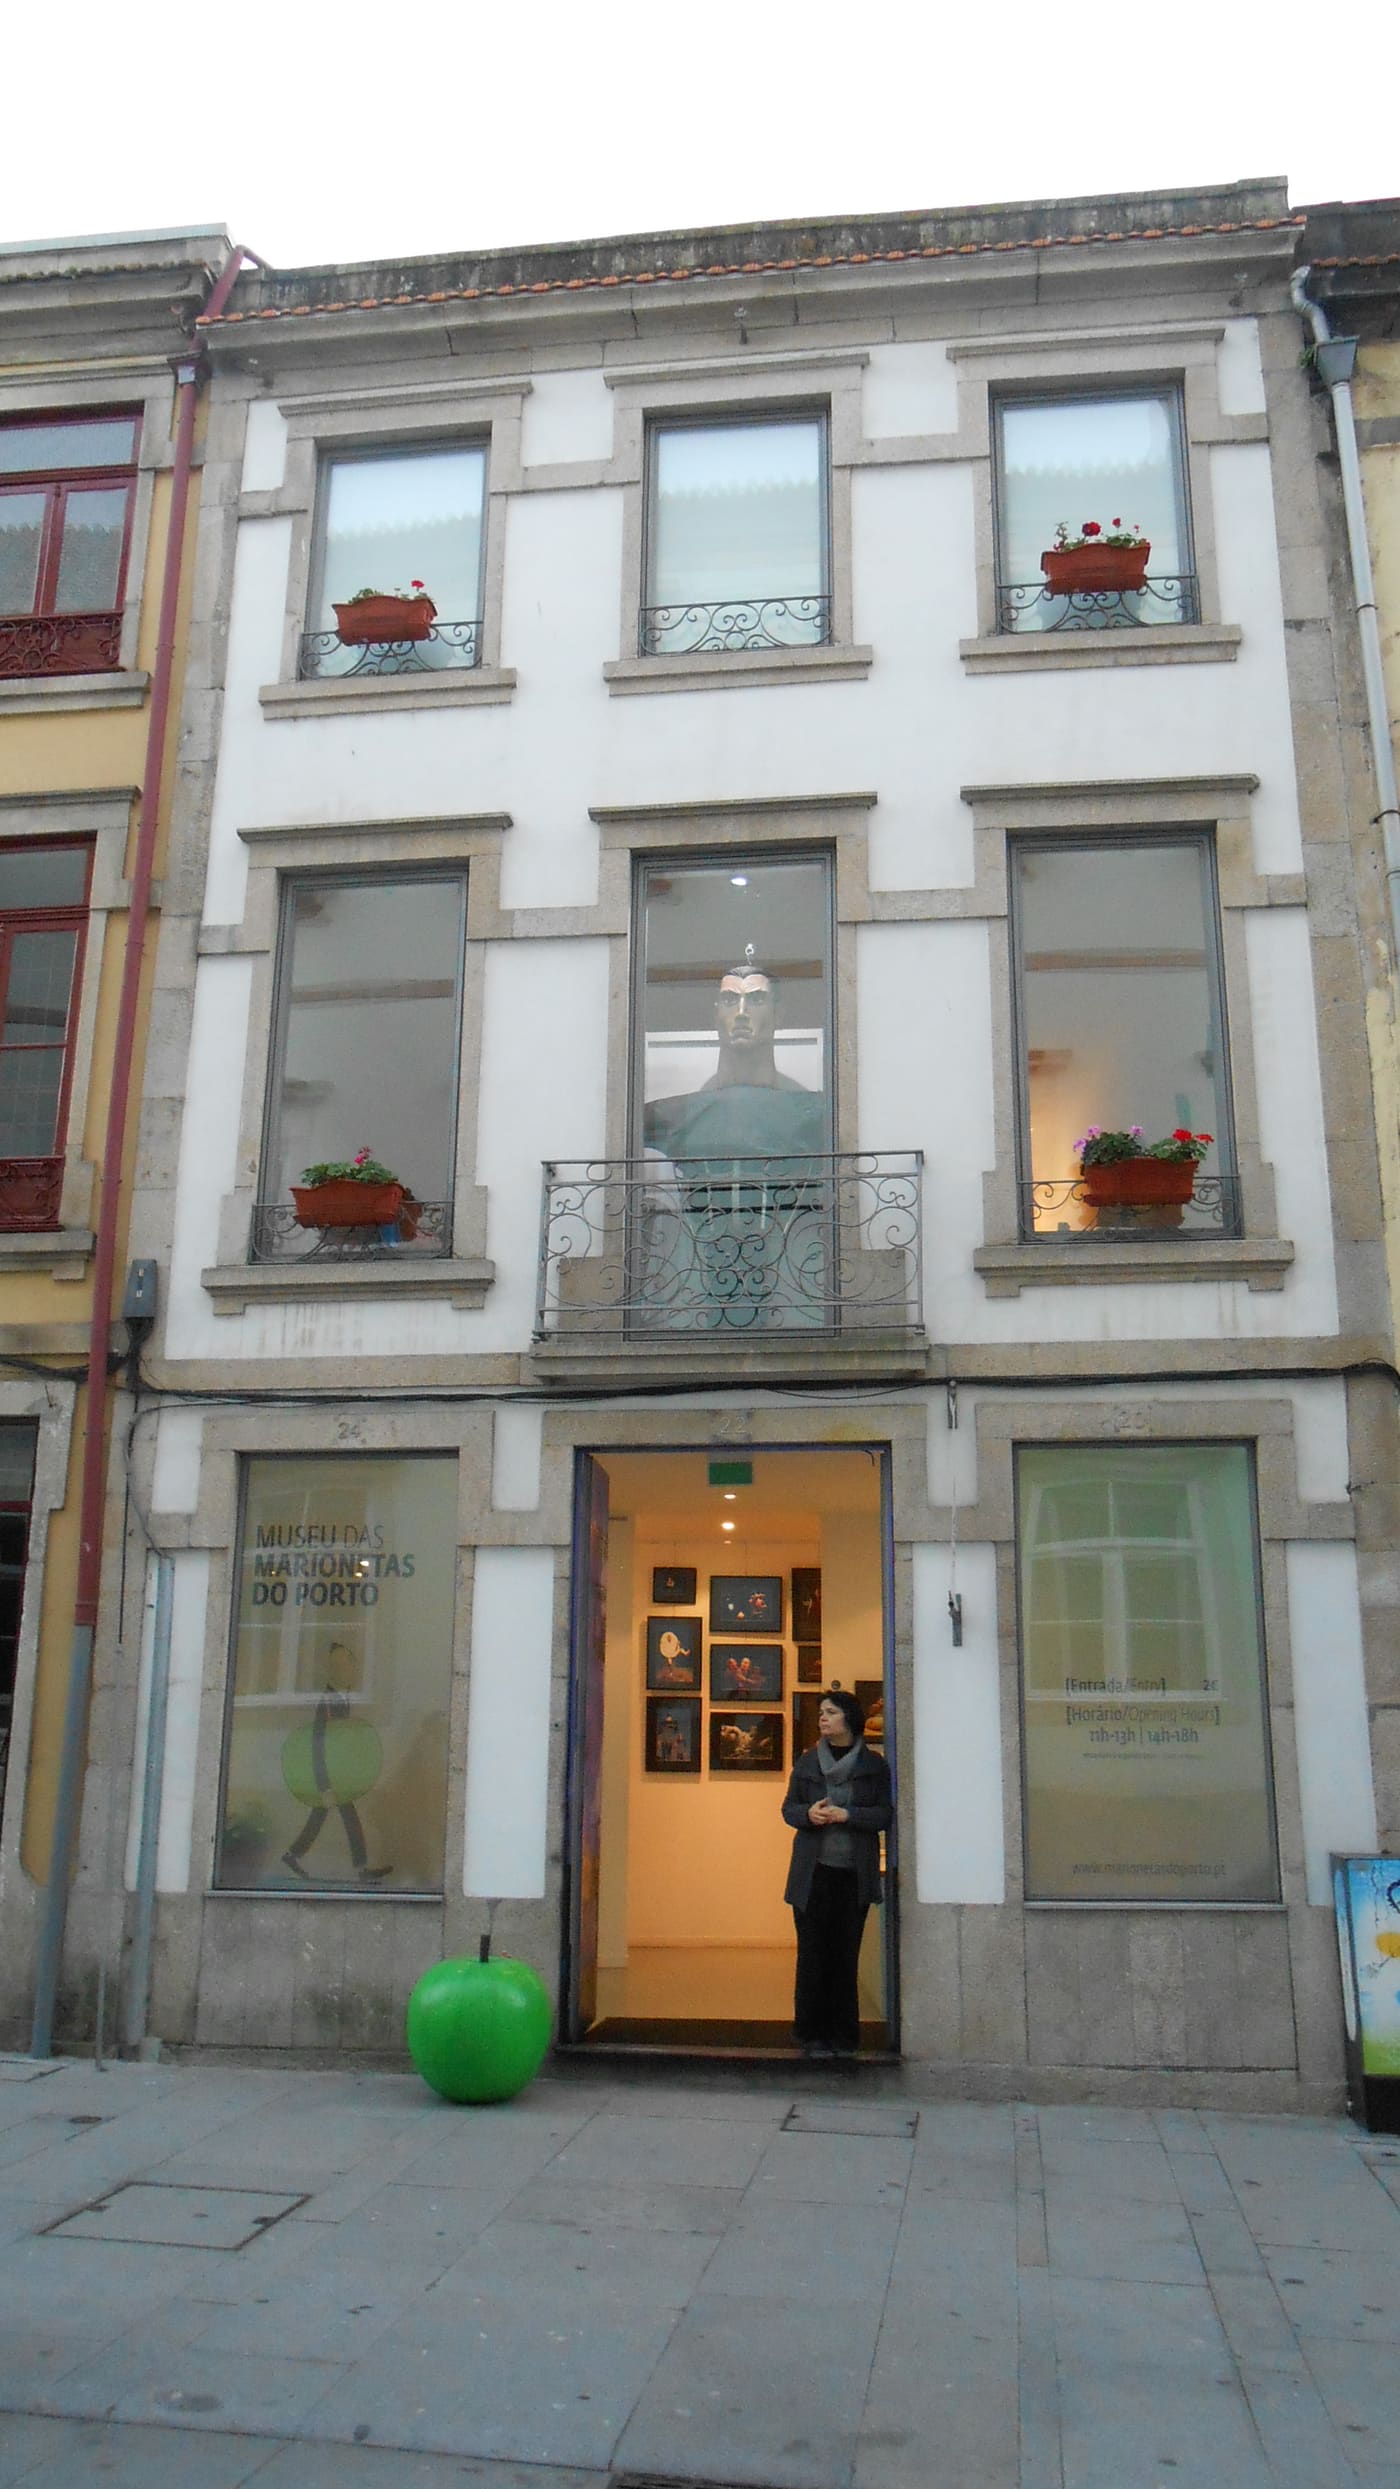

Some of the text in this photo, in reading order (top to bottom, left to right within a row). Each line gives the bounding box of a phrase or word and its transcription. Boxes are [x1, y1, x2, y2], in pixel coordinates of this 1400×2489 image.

[720, 1416, 747, 1434] 22
[256, 1524, 384, 1549] MUSEU DAS
[252, 1582, 379, 1606] DO PORTO
[1147, 1727, 1199, 1745] 14h-18h
